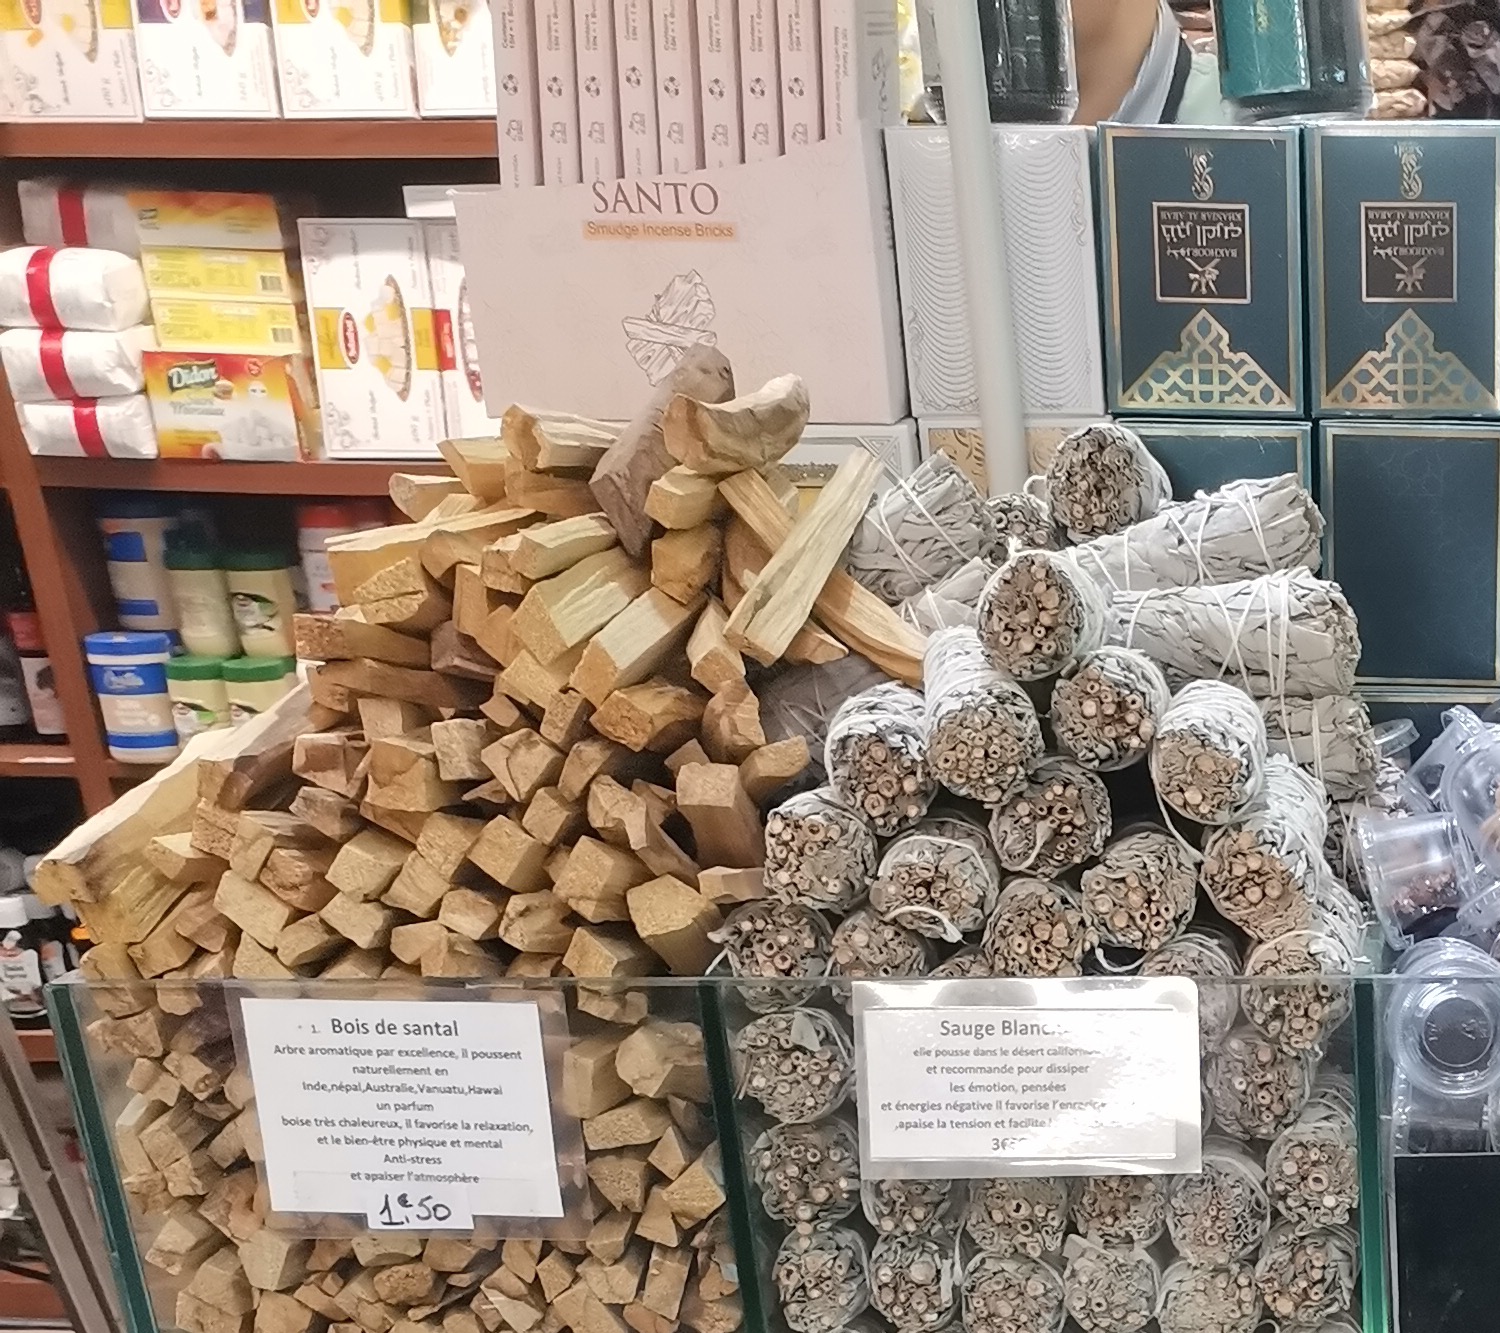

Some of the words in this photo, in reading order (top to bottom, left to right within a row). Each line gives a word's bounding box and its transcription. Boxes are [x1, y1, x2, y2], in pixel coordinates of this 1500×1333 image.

[591, 181, 719, 215] SANTO
[587, 221, 639, 239] Smudge
[643, 223, 692, 237] Incense
[695, 223, 734, 238] Bricks
[330, 1018, 370, 1035] Bois
[375, 1018, 398, 1036] de
[402, 1019, 459, 1037] santal
[939, 1019, 996, 1041] Sauge
[925, 1064, 938, 1075] et
[940, 1063, 1015, 1075] recommande
[1017, 1065, 1044, 1077] pour
[1045, 1062, 1090, 1076] dissiper
[949, 1081, 966, 1093] les
[967, 1081, 1018, 1094] émotion,
[1021, 1080, 1067, 1095] pensées
[383, 1153, 443, 1165] Anti-stress
